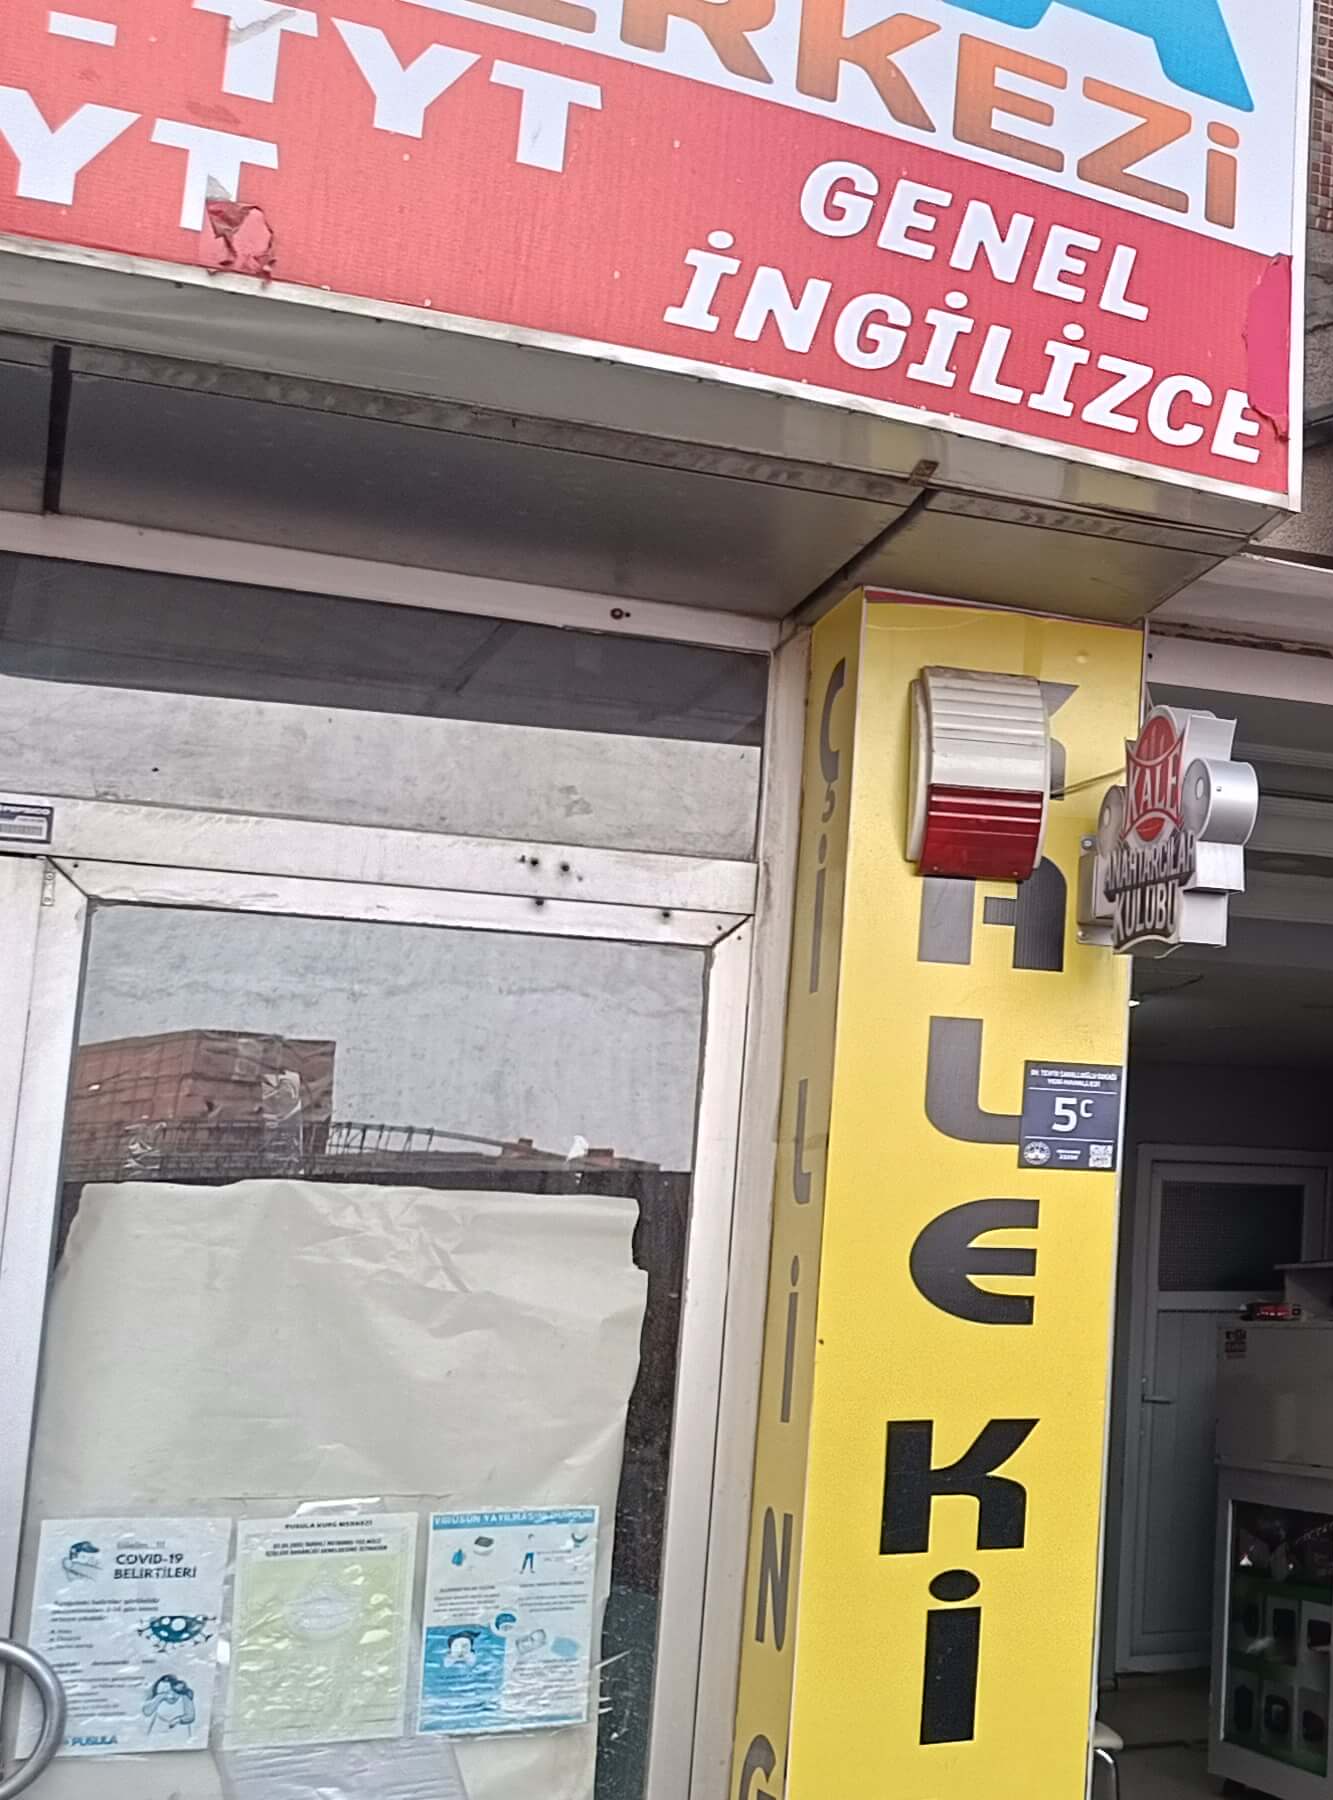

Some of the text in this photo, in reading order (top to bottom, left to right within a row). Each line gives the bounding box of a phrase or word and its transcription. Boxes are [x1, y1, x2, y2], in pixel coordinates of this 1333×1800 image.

[192, 0, 602, 173] TYT
[801, 160, 1151, 321] GENEL
[664, 230, 1262, 465] İNGİLİZCE
[1122, 756, 1178, 825] KALE
[1105, 829, 1196, 891] ANAHTARCILAR
[908, 681, 1079, 1325] ALE
[113, 1565, 197, 1580] BELİRTİLERİ
[115, 1552, 184, 1566] COVID-19
